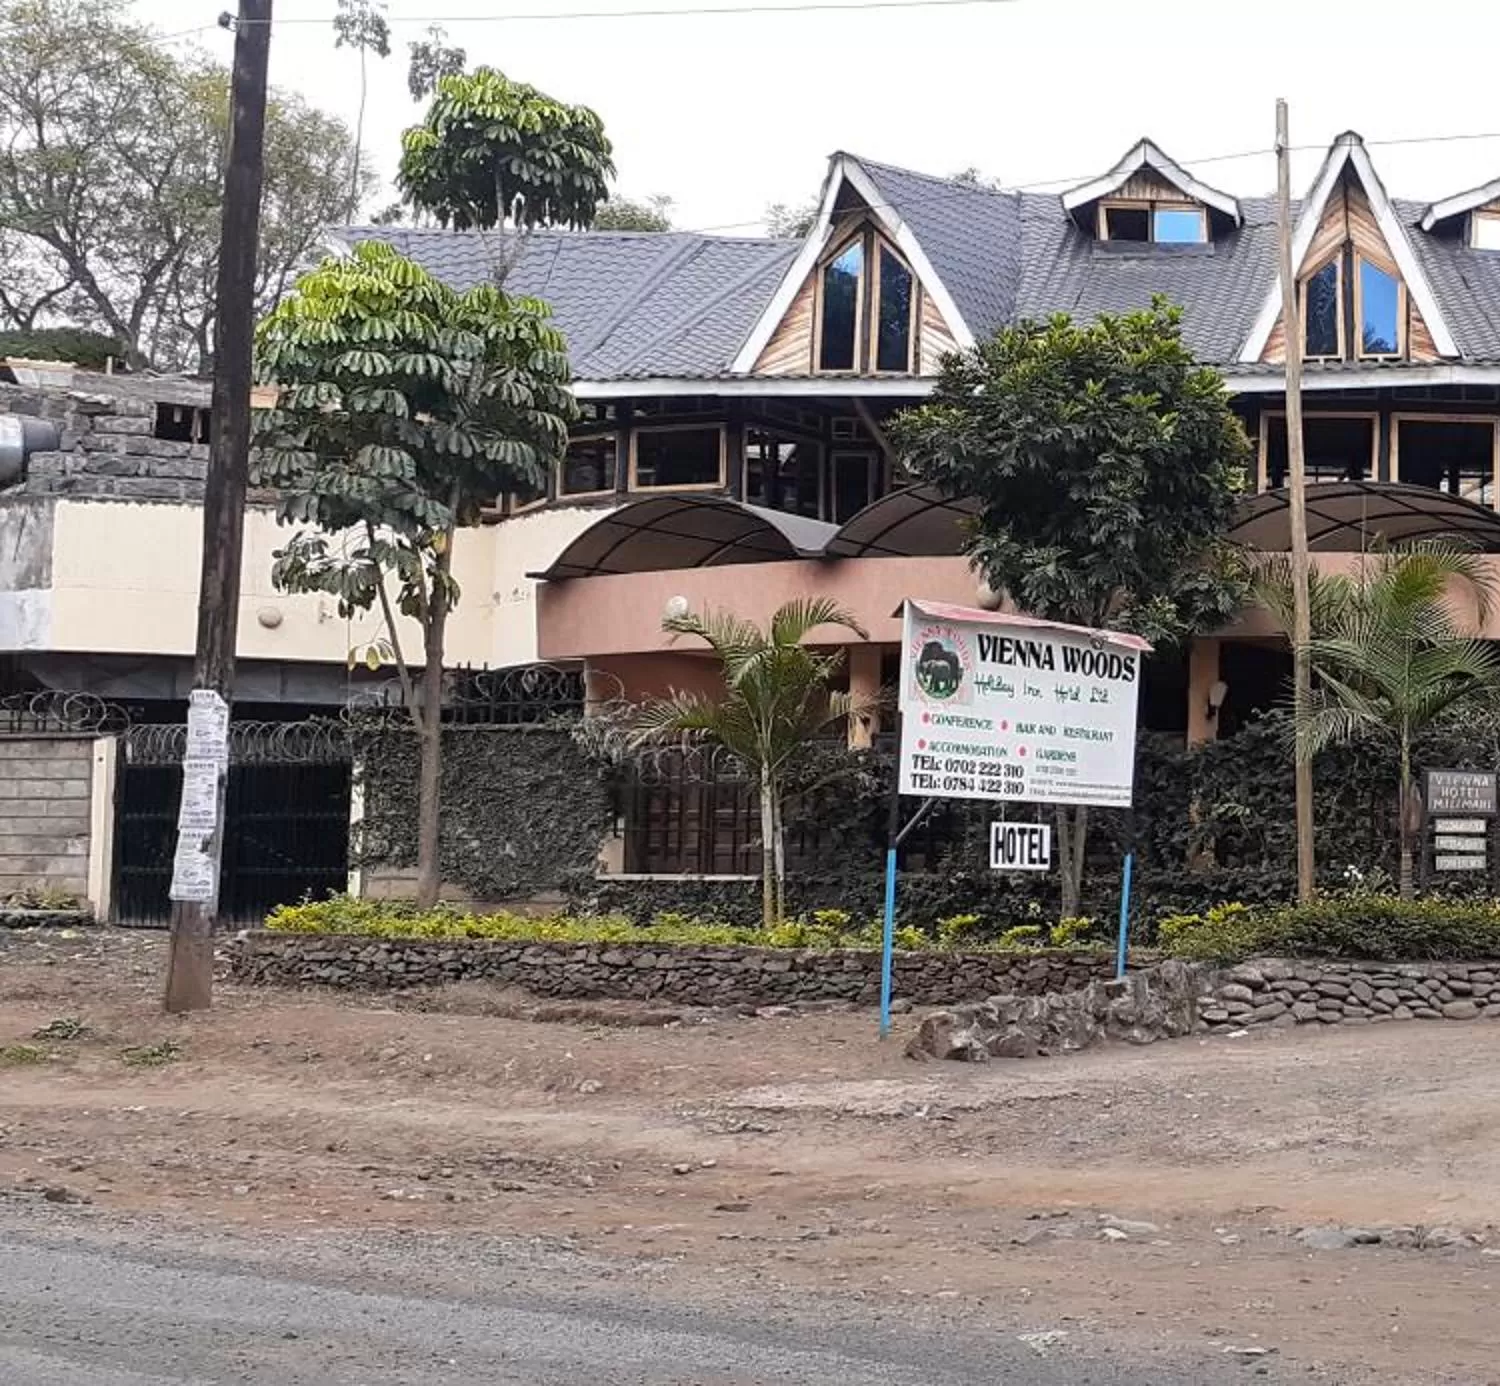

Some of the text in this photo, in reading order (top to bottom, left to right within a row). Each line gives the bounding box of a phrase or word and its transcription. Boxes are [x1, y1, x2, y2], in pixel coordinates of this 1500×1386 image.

[977, 633, 1136, 682] VIENNA WOODS
[974, 671, 1015, 698] Holiday
[931, 713, 994, 731] CONFERENCE
[1015, 722, 1114, 742] BAR AND RESTAURANT
[945, 758, 976, 775] 0702
[978, 761, 1001, 777] 222
[1004, 764, 1025, 779] 310
[944, 776, 975, 791] 0784
[978, 778, 1002, 793] 422
[1004, 780, 1025, 796] 310
[1435, 774, 1489, 786] VIENNA
[1441, 787, 1479, 798] HOTEL
[995, 826, 1048, 865] HOTEL
